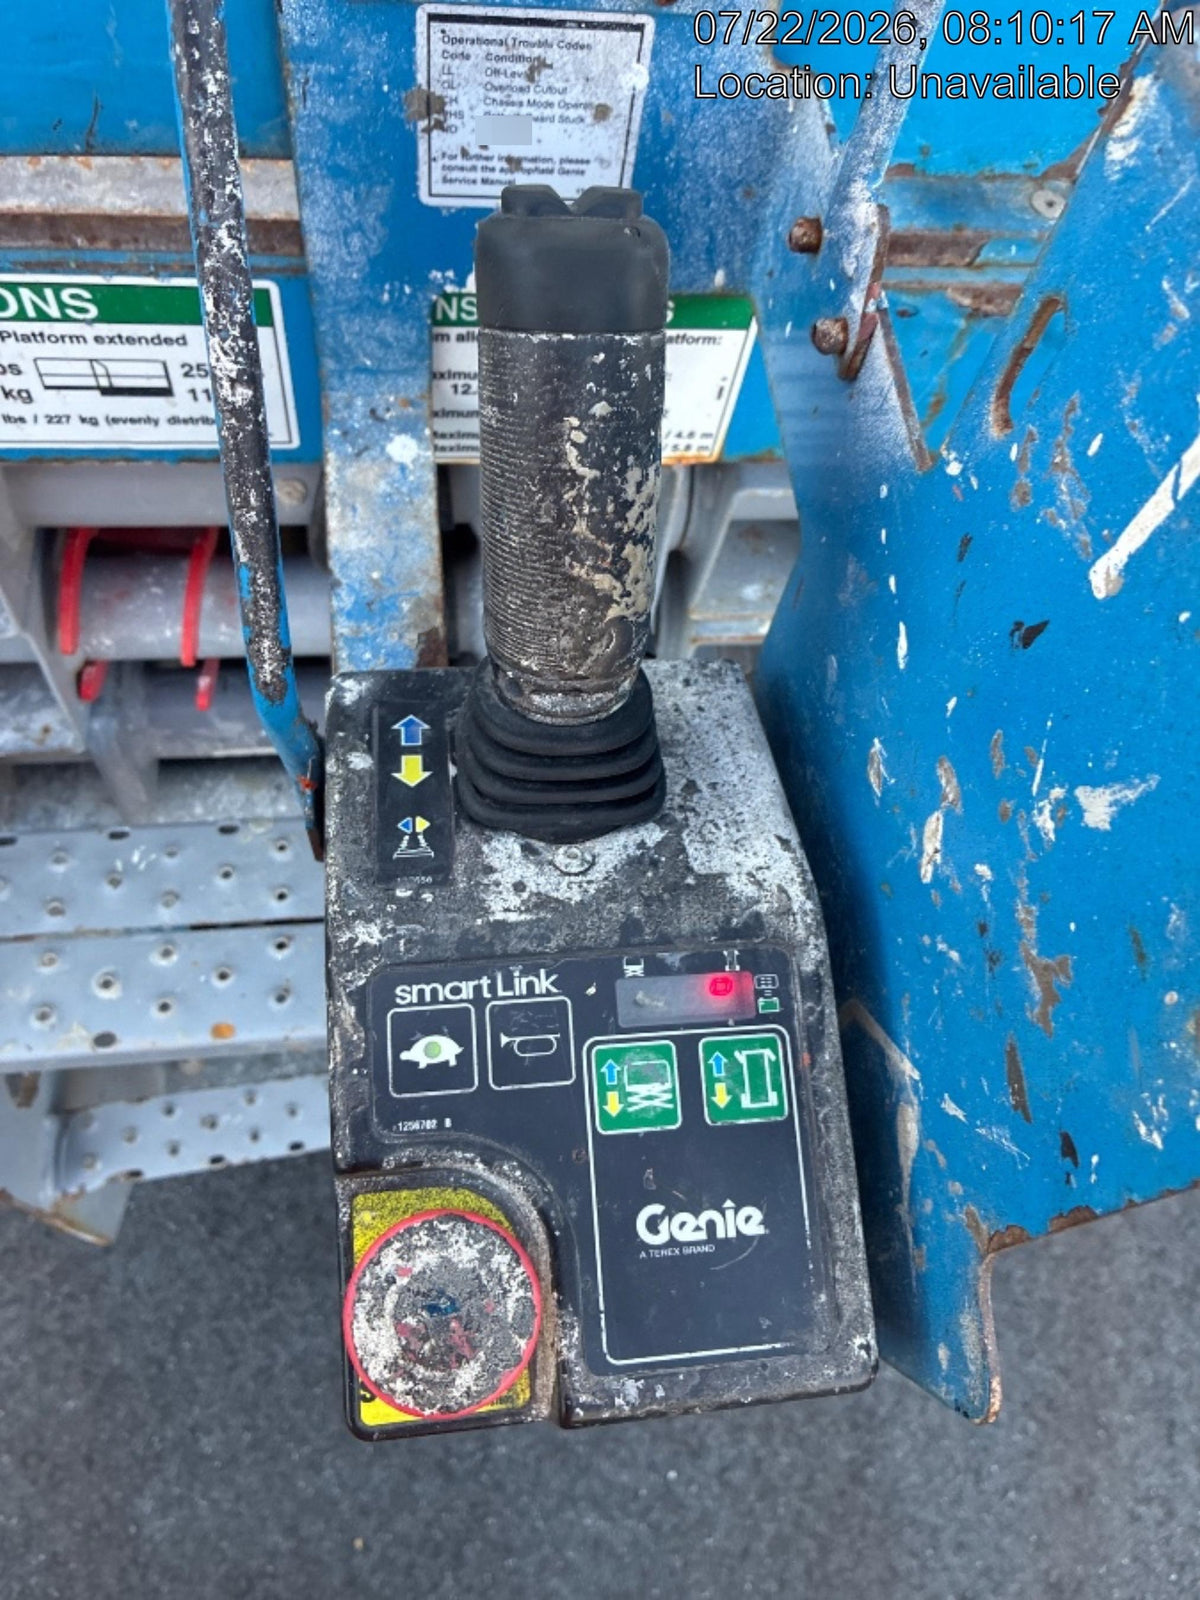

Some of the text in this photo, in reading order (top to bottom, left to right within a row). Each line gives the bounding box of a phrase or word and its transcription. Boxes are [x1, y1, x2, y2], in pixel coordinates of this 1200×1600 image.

[441, 34, 508, 48] Operational
[527, 98, 555, 109] Mode
[441, 151, 457, 161] For
[559, 157, 590, 168] please
[480, 164, 496, 174] the
[441, 174, 478, 186] Service
[0, 329, 188, 348] Platform extended
[1, 386, 34, 404] kg
[2, 413, 26, 425] lbs
[45, 414, 71, 425] 227
[79, 414, 99, 426] kg
[106, 413, 160, 427] (evenly
[635, 1197, 766, 1246] Genie
[640, 1244, 716, 1259] A TEREX BRAND
